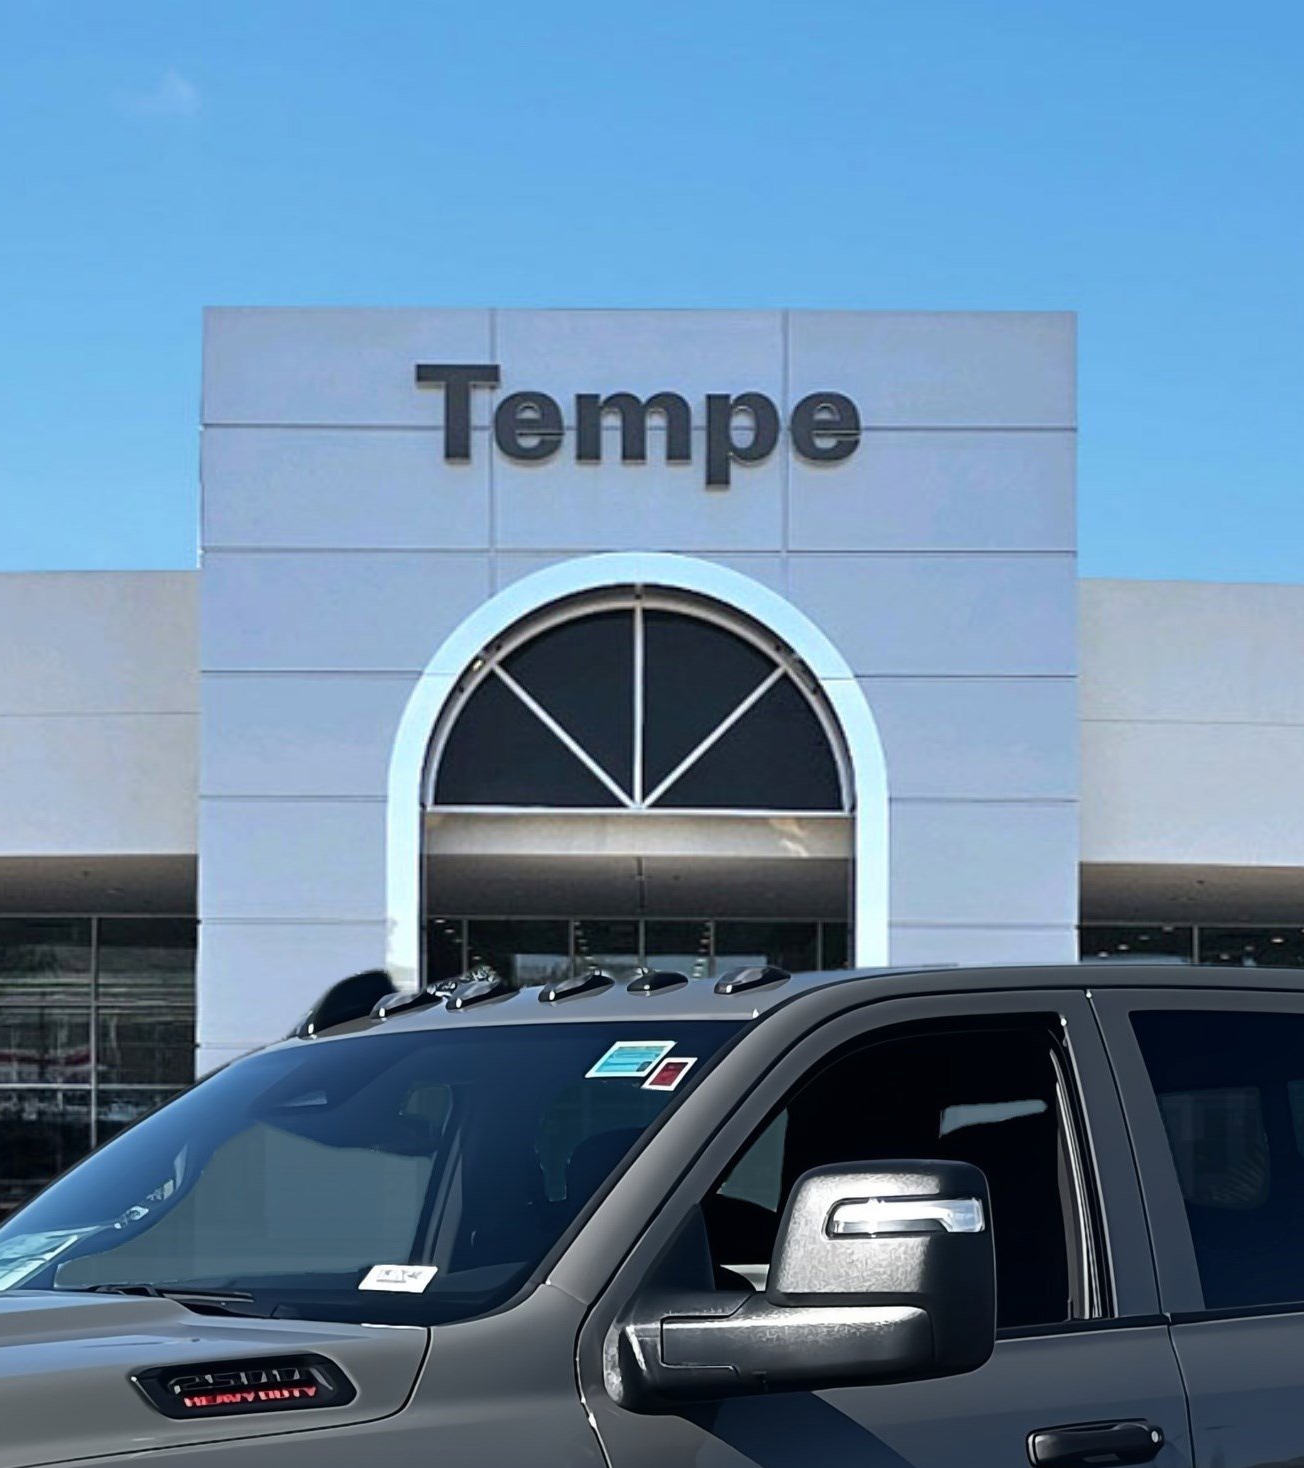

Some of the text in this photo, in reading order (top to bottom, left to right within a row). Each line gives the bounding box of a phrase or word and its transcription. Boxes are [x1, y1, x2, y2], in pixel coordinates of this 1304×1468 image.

[415, 363, 862, 490] Tempe
[182, 1384, 318, 1408] HEAVY DUTY
